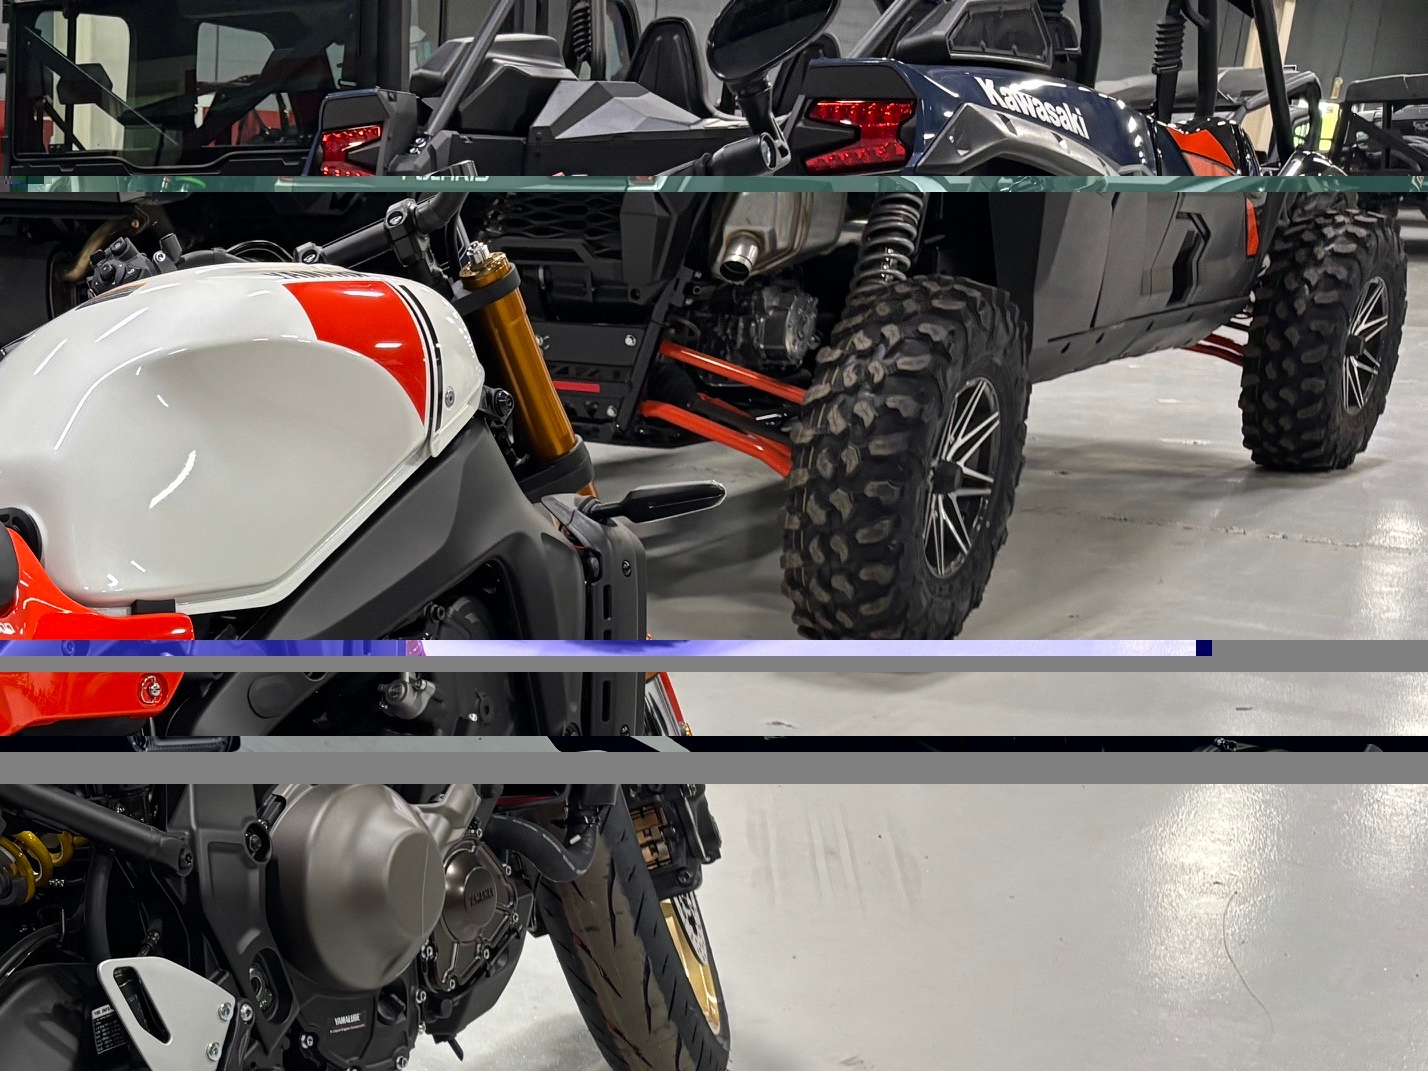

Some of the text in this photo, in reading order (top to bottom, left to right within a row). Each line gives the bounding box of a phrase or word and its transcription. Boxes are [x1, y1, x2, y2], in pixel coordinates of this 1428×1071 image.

[973, 76, 1090, 140] Kawasaki
[468, 886, 494, 907] YAMAHA
[334, 1012, 361, 1026] YAMALUBE
